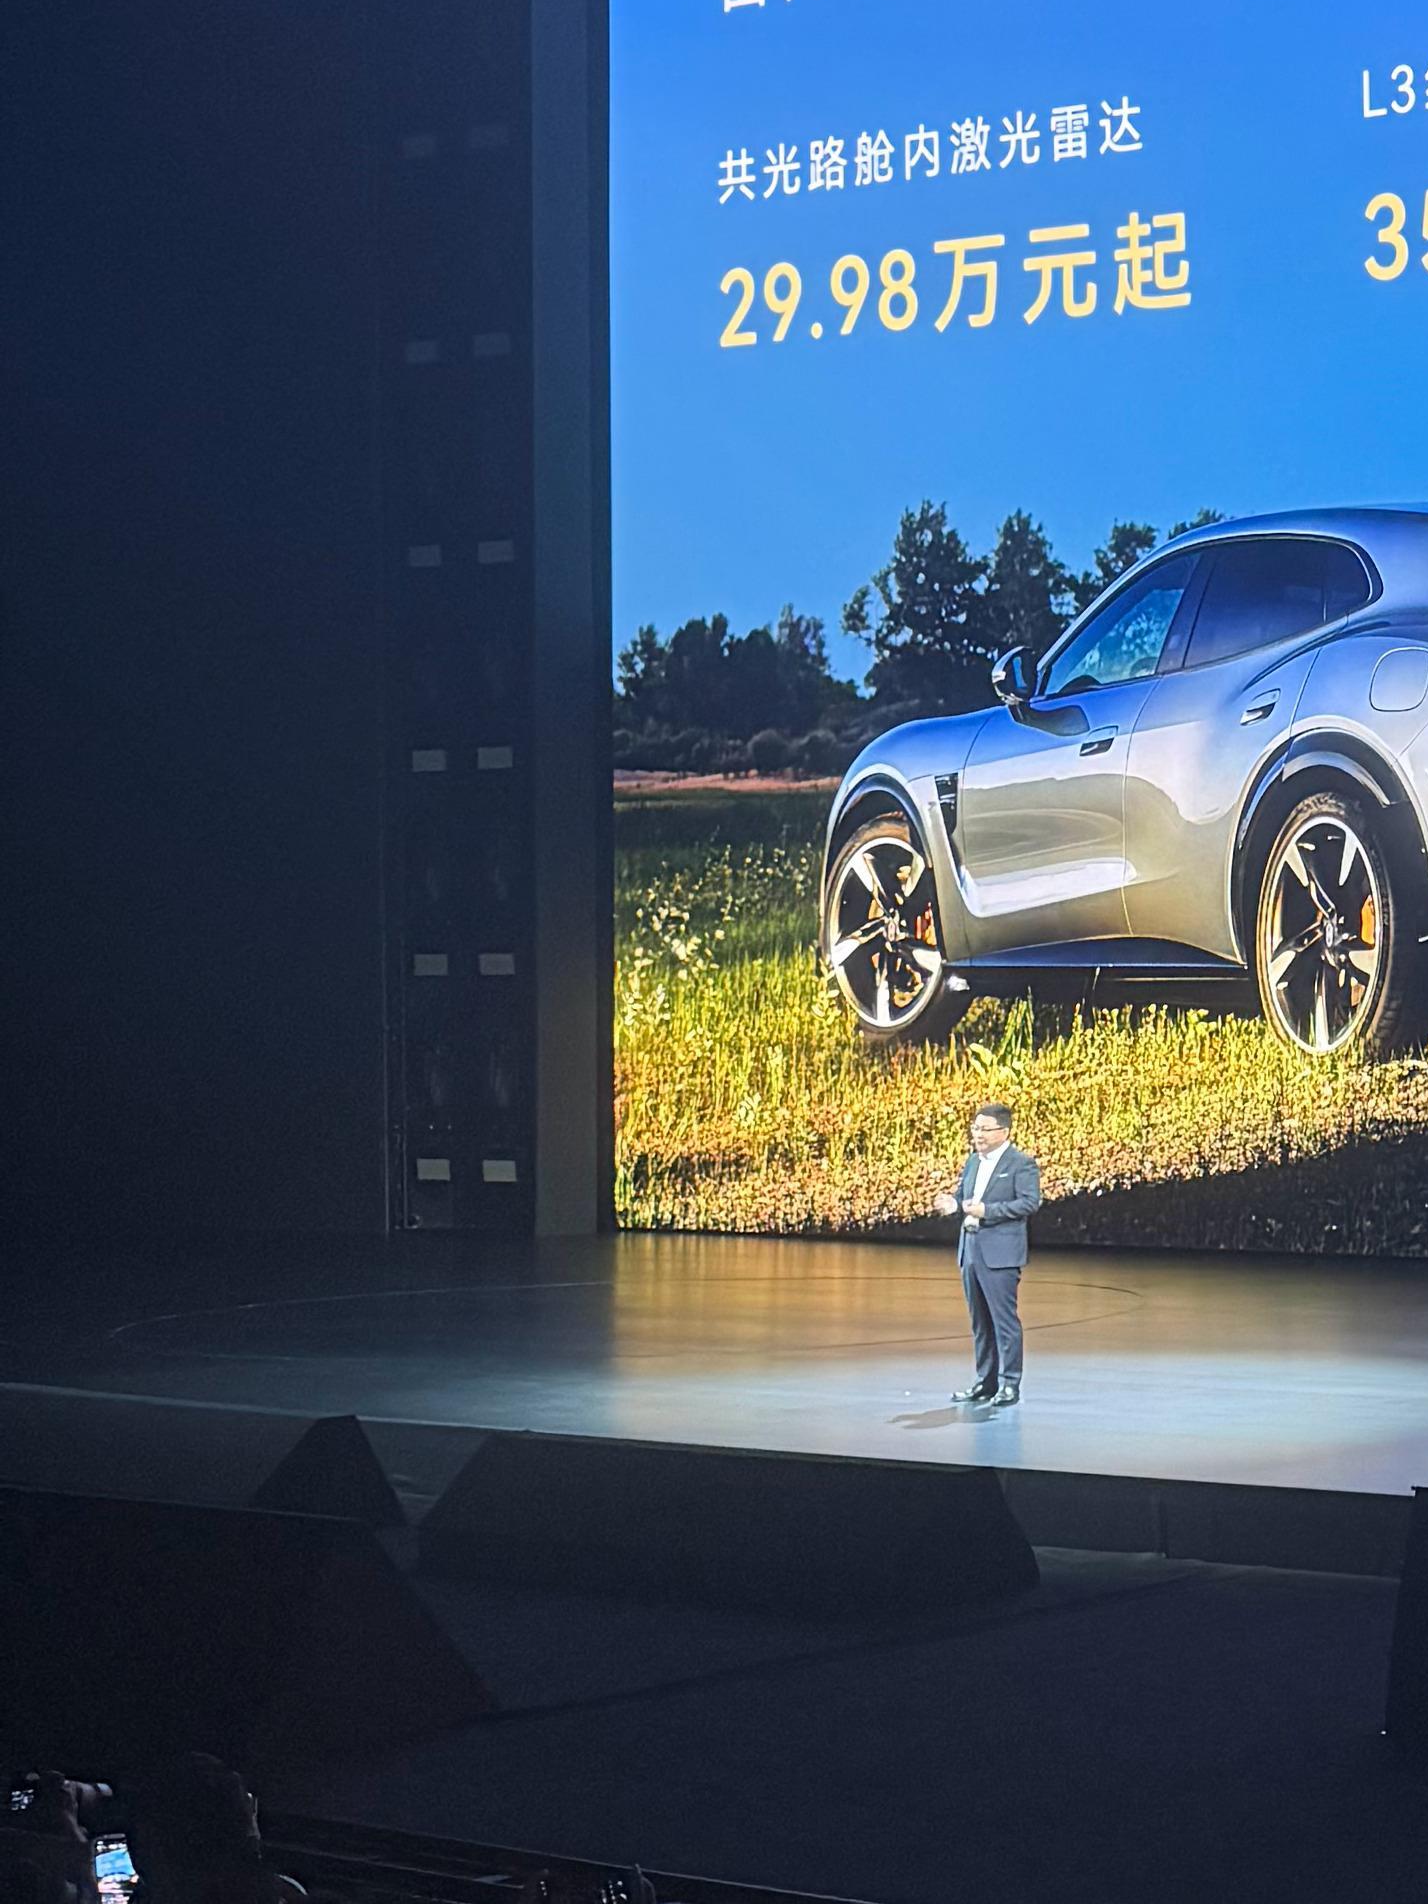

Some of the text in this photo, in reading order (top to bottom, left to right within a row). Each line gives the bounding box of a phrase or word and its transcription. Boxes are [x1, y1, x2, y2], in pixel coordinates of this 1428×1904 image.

[717, 95, 1144, 204] 共光路舱内激光雷达
[719, 210, 1192, 348] 29.98万元起
